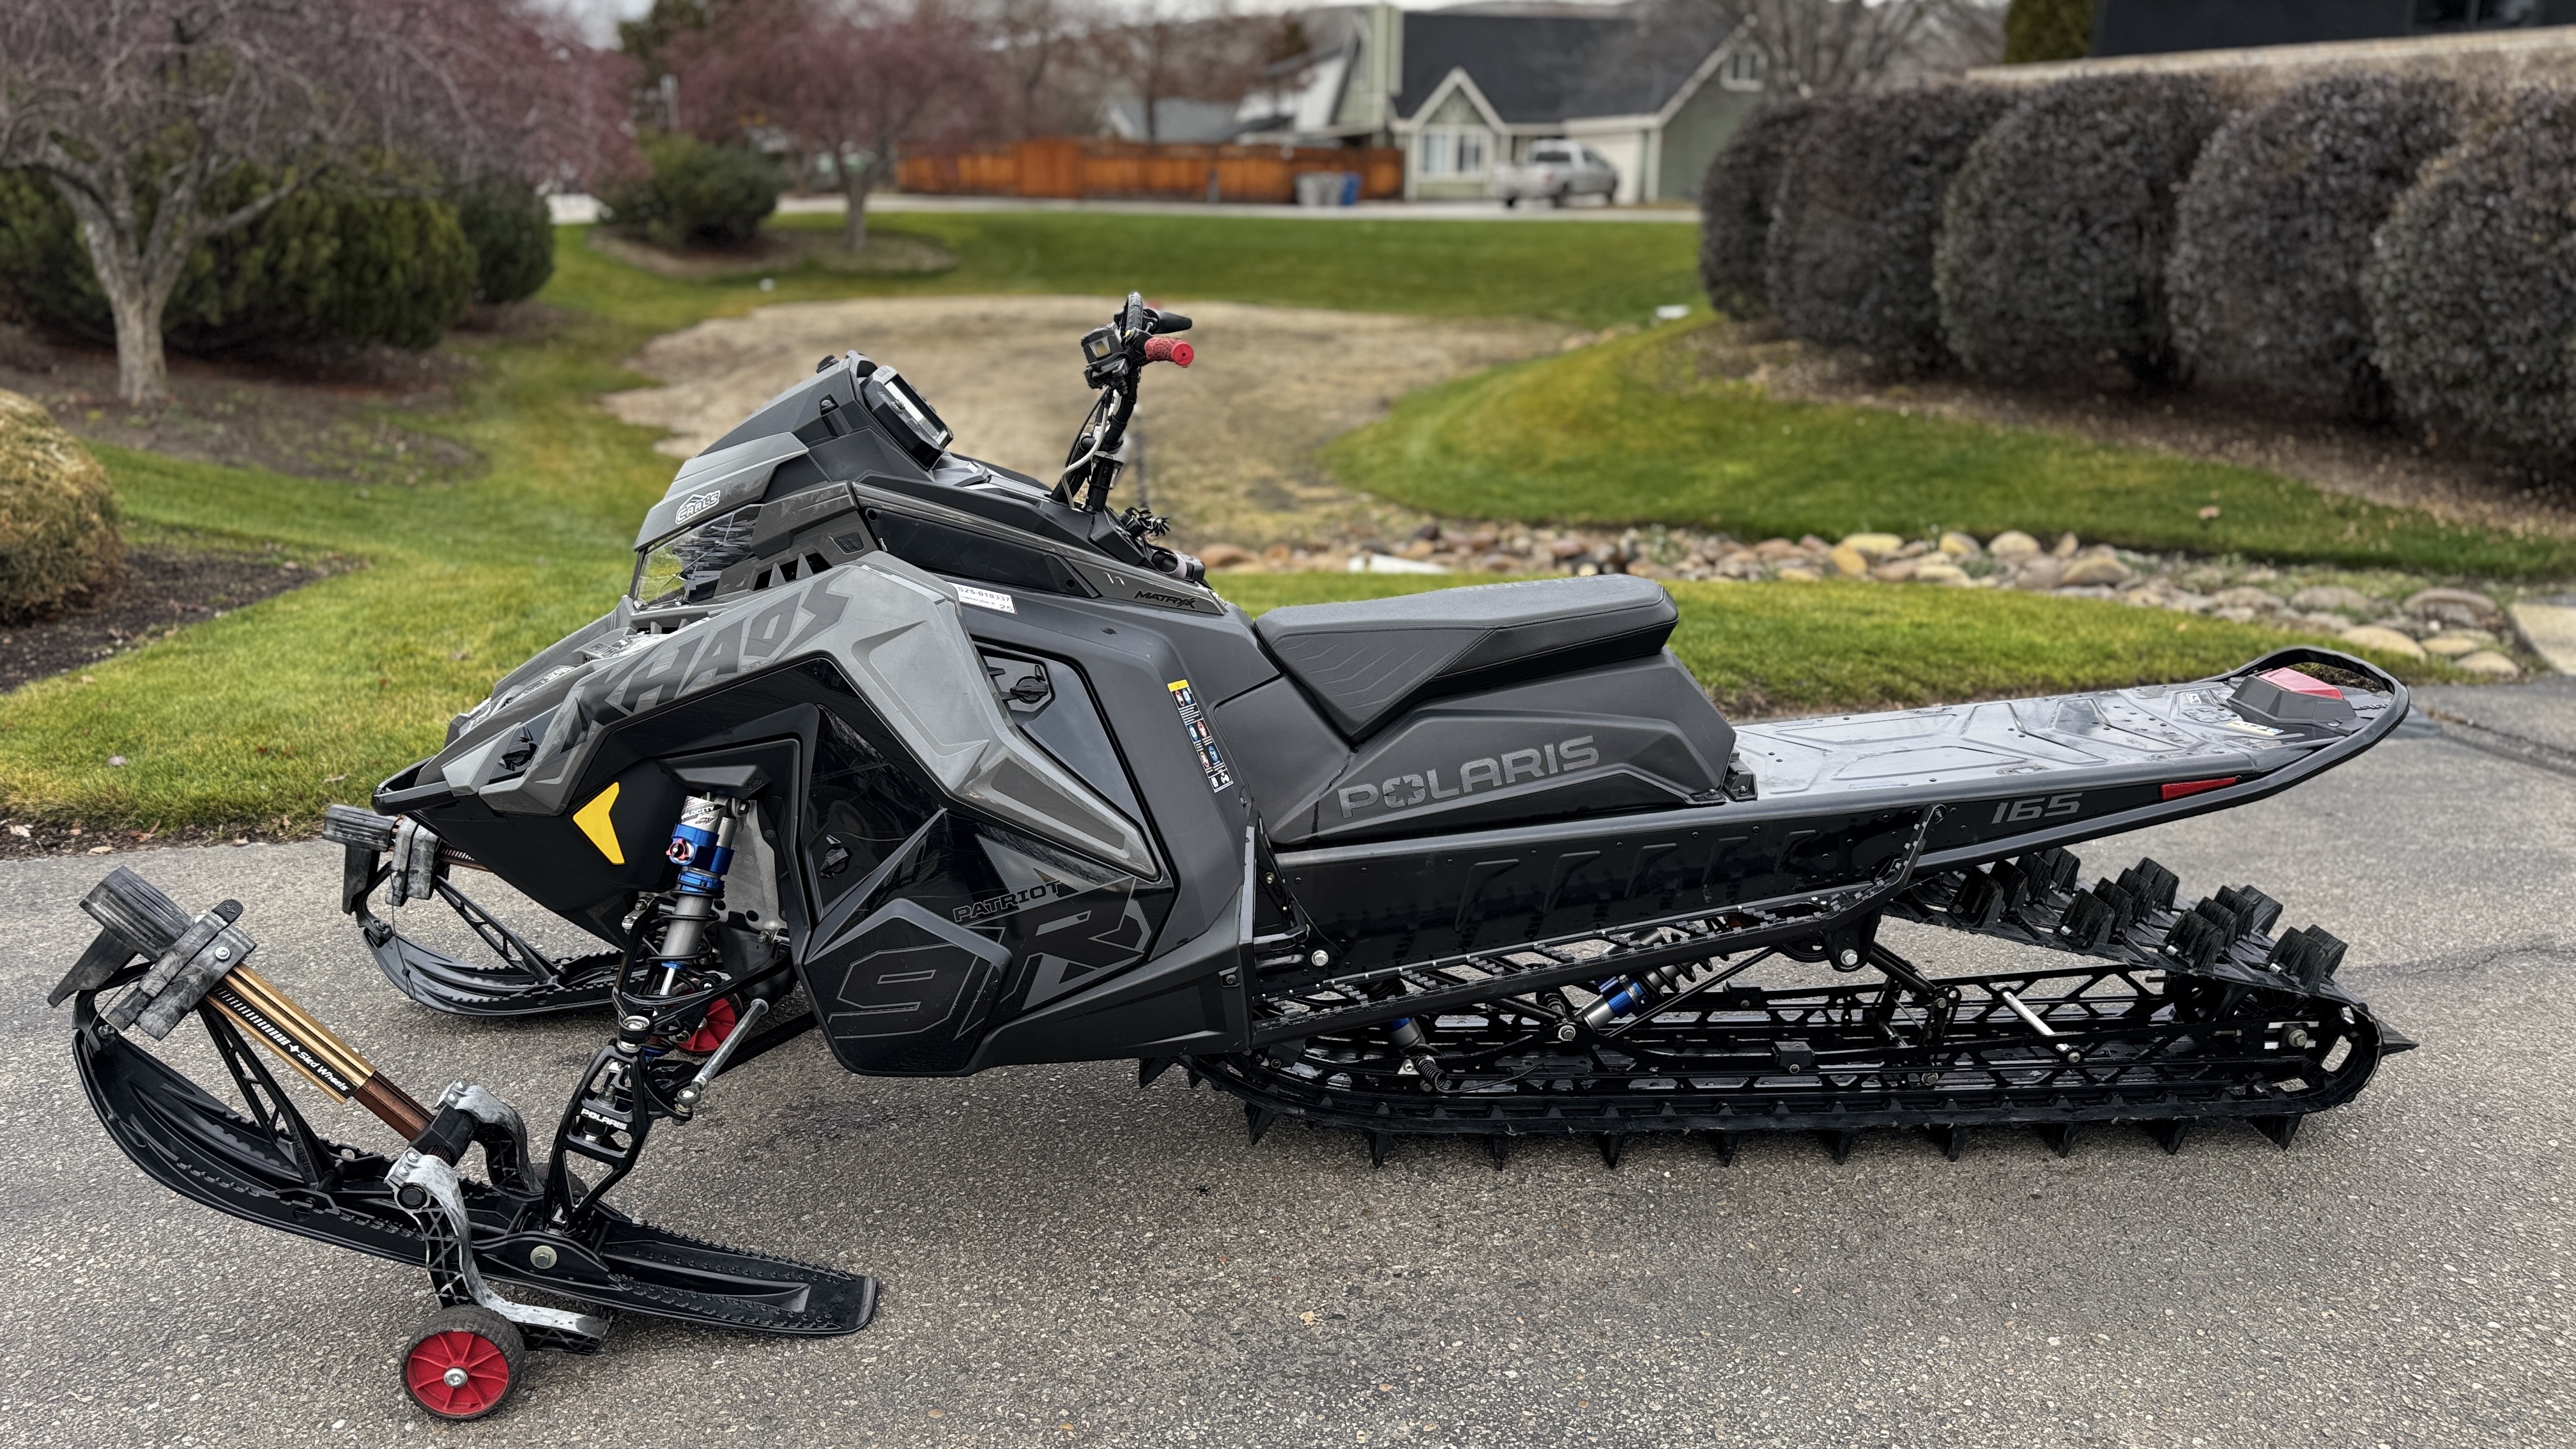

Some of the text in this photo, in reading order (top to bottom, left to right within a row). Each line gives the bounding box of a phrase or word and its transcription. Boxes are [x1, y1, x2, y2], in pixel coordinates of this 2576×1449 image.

[1134, 590, 1196, 609] MATRYX
[560, 567, 853, 754] KHAOS
[1338, 735, 1600, 819] POLARIS
[681, 806, 714, 819] VELOCITY
[1991, 792, 2083, 824] 165
[953, 880, 1061, 923] PATRIOT
[297, 1052, 349, 1091] Sled Wheels
[580, 1107, 628, 1130] POLARIS
[289, 1125, 313, 1174] POLARIS
